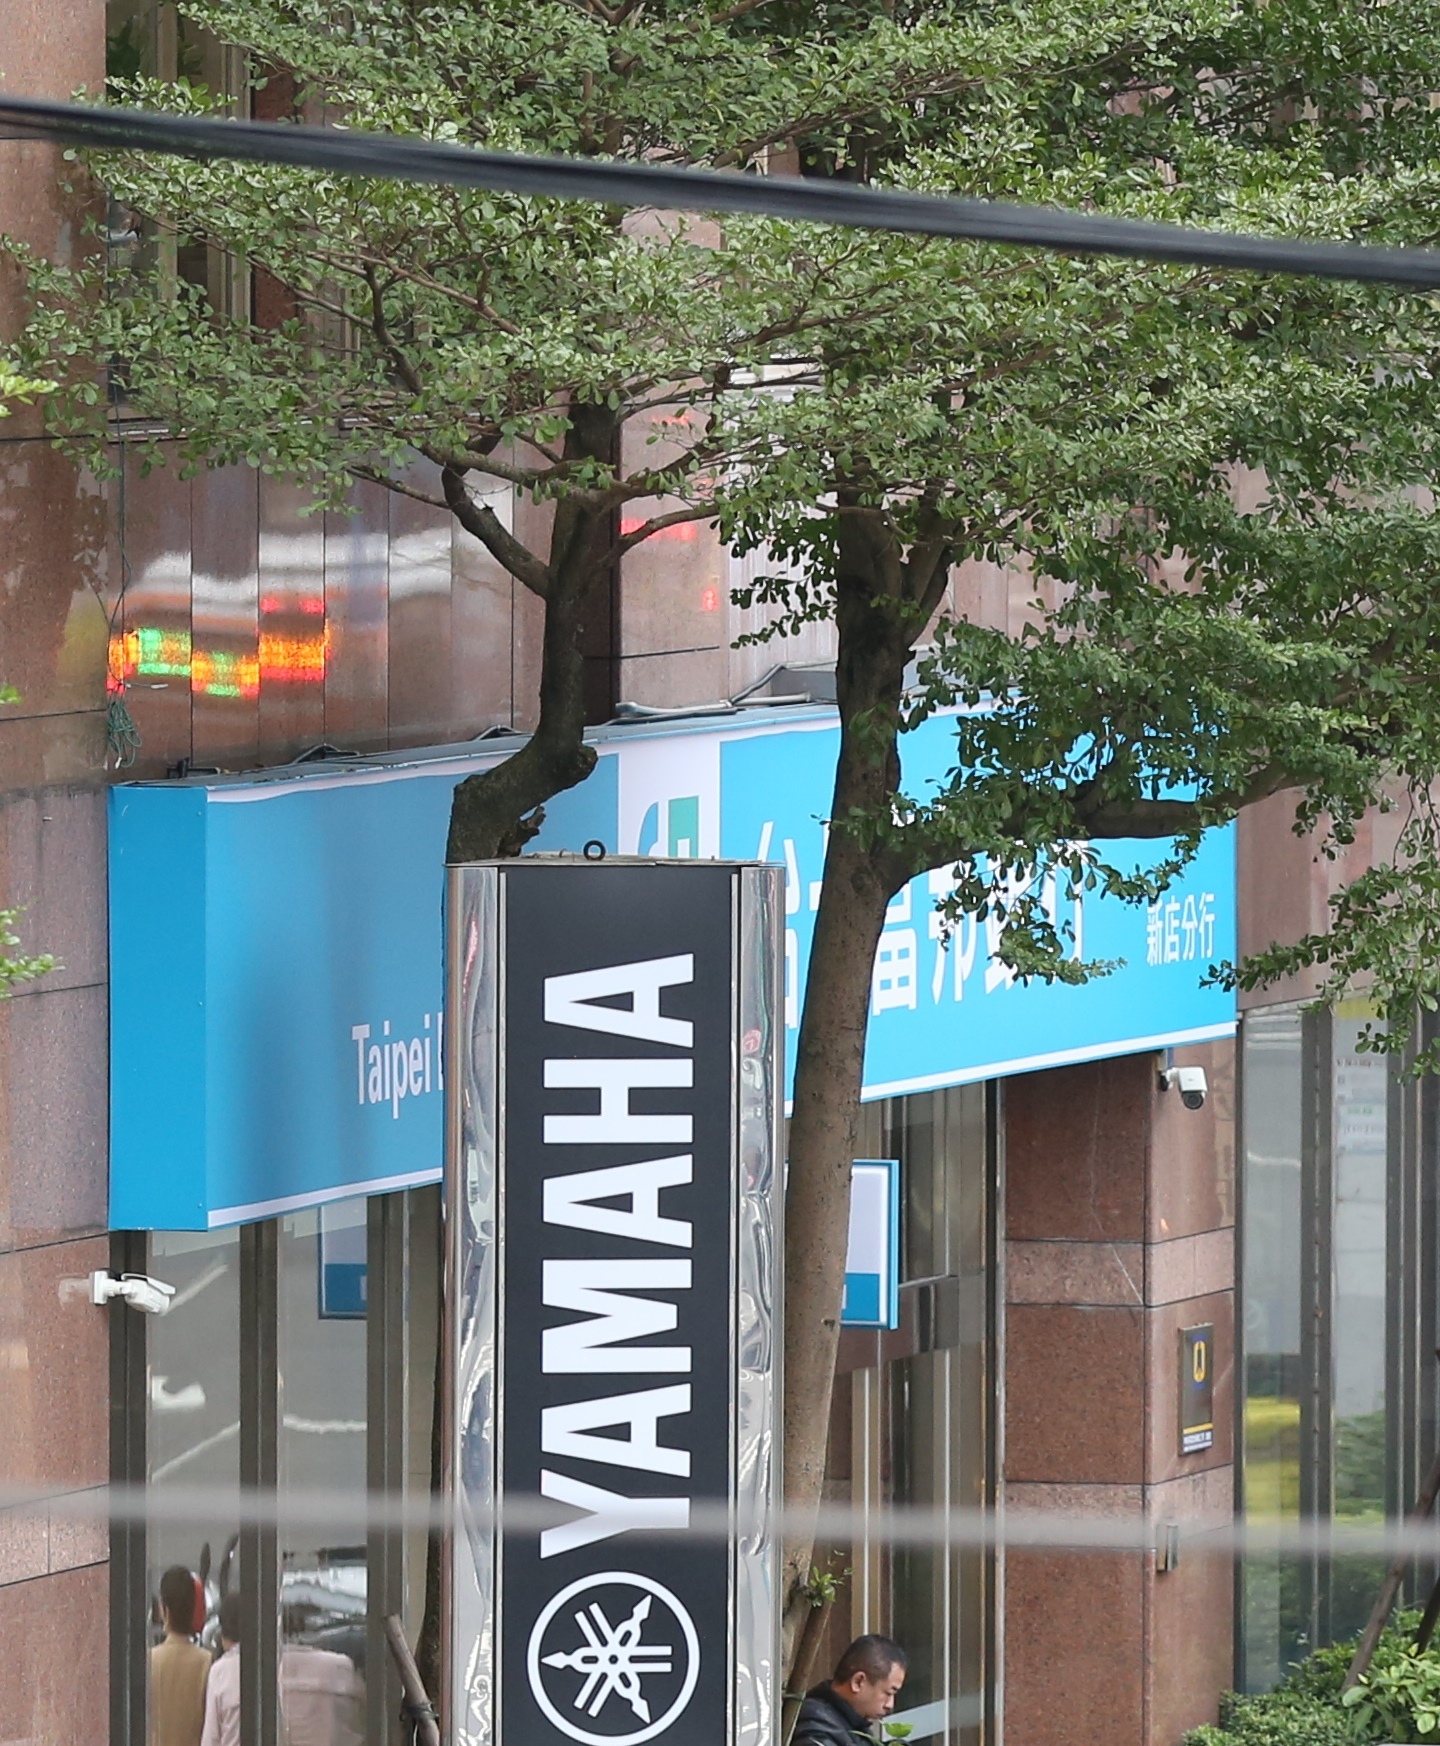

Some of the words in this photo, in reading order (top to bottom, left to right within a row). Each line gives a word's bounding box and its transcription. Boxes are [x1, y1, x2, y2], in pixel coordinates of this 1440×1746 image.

[1145, 892, 1217, 967] 新店分行
[351, 1013, 431, 1121] Taipei
[541, 952, 695, 1560] YAMAHA
